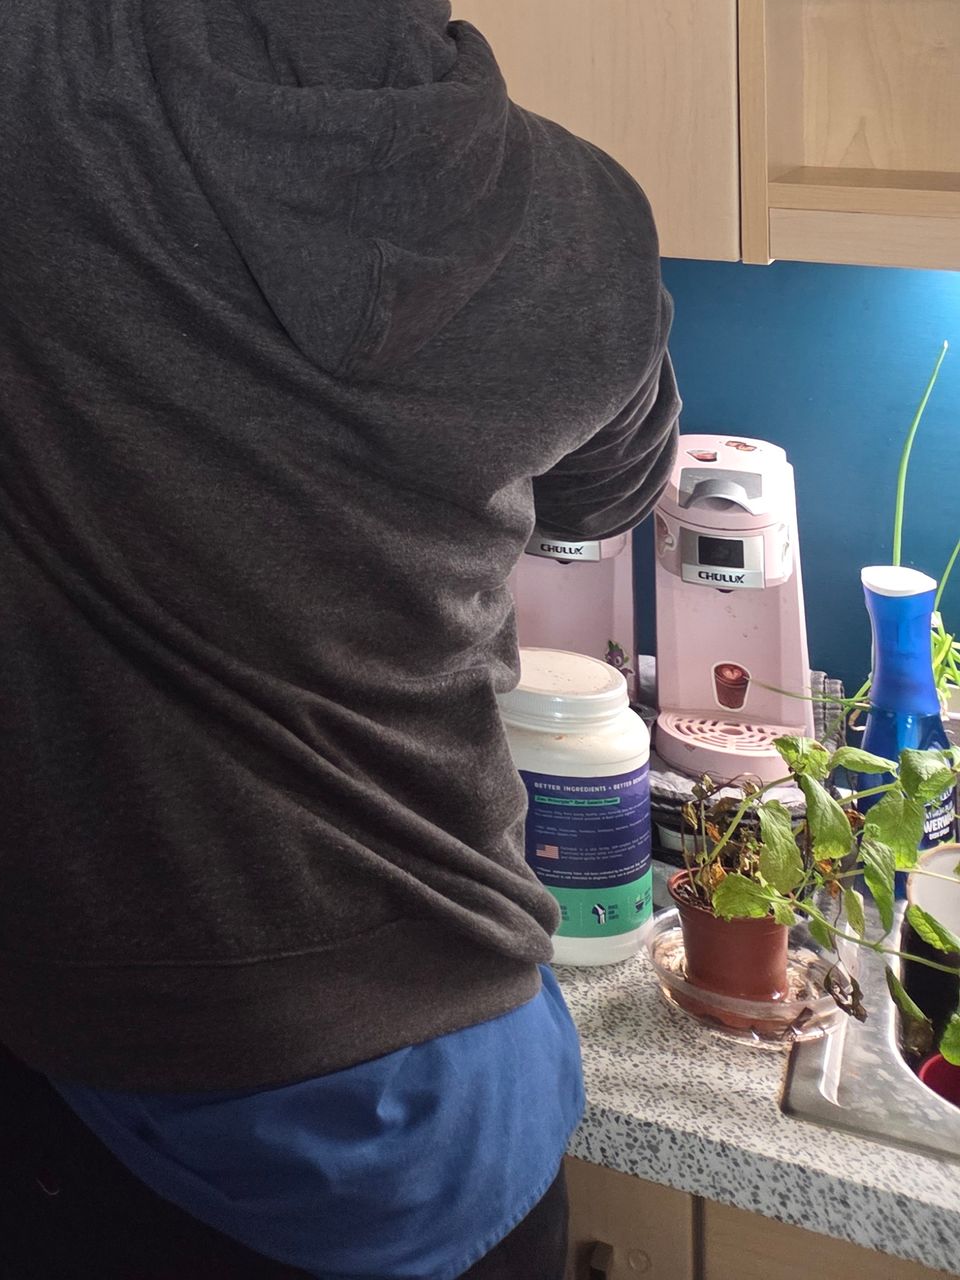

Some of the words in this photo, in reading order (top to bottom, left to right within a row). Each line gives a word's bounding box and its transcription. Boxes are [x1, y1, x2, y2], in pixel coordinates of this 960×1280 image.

[540, 543, 584, 556] CHULUX
[698, 570, 746, 584] CHULUX
[534, 782, 560, 791] BETTER
[563, 785, 606, 793] INGREDIENTS
[613, 780, 632, 790] BETTER
